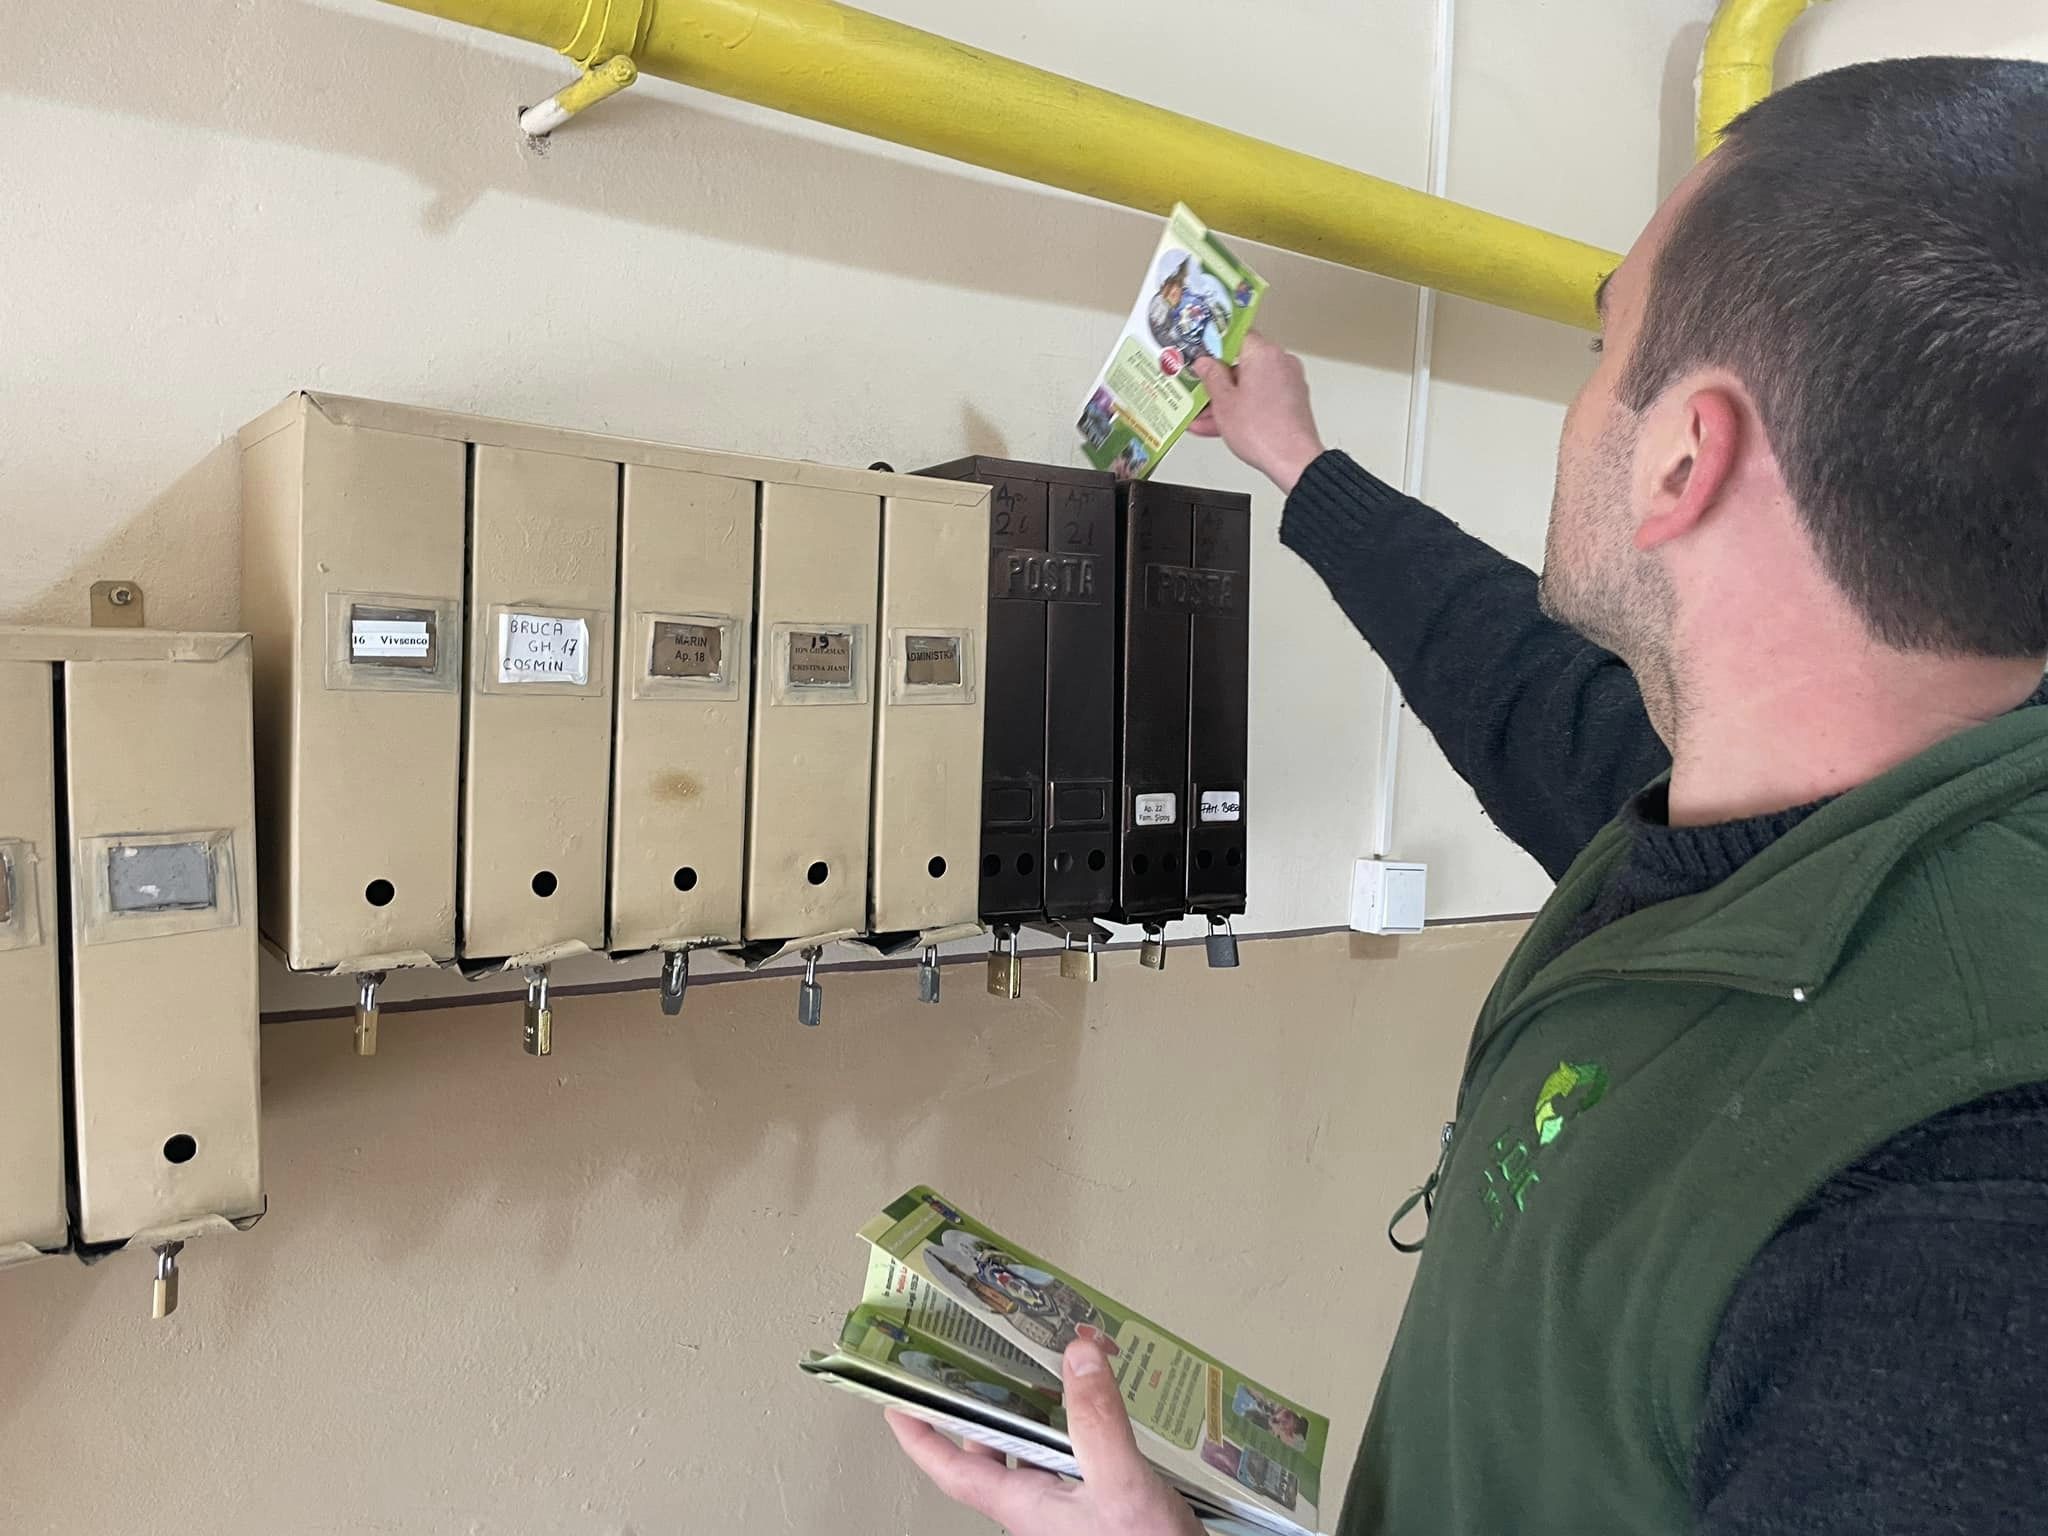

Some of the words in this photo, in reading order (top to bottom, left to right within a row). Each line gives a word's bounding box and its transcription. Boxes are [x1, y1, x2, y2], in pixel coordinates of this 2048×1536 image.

[510, 619, 563, 636] BRUCA
[353, 635, 366, 646] 16
[560, 638, 578, 656] 17
[674, 634, 708, 648] MARIN
[811, 635, 830, 648] 19
[674, 650, 692, 663] Ap.
[695, 652, 705, 662] 18
